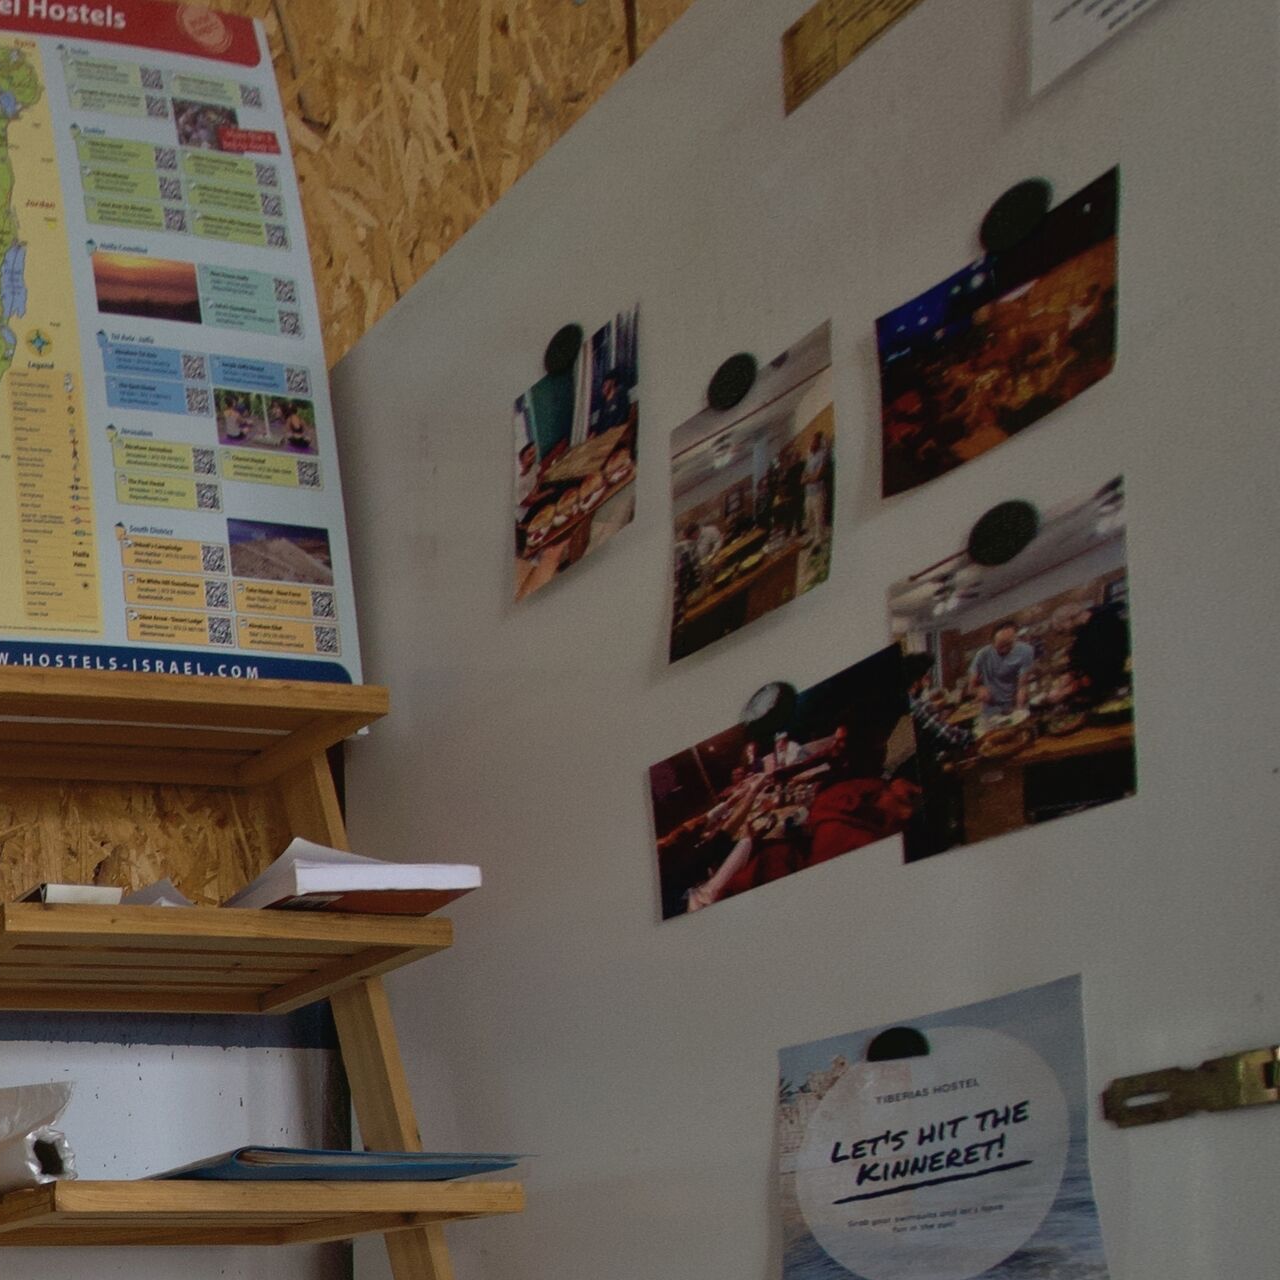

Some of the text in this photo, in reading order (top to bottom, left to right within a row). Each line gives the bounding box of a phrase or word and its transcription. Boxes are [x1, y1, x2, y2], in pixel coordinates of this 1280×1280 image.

[28, 0, 126, 28] Hostels
[875, 1077, 980, 1105] TIBERIAS HOSTEL
[831, 1100, 1031, 1164] LET'S HIT THE
[856, 1133, 1007, 1187] KINNERET!
